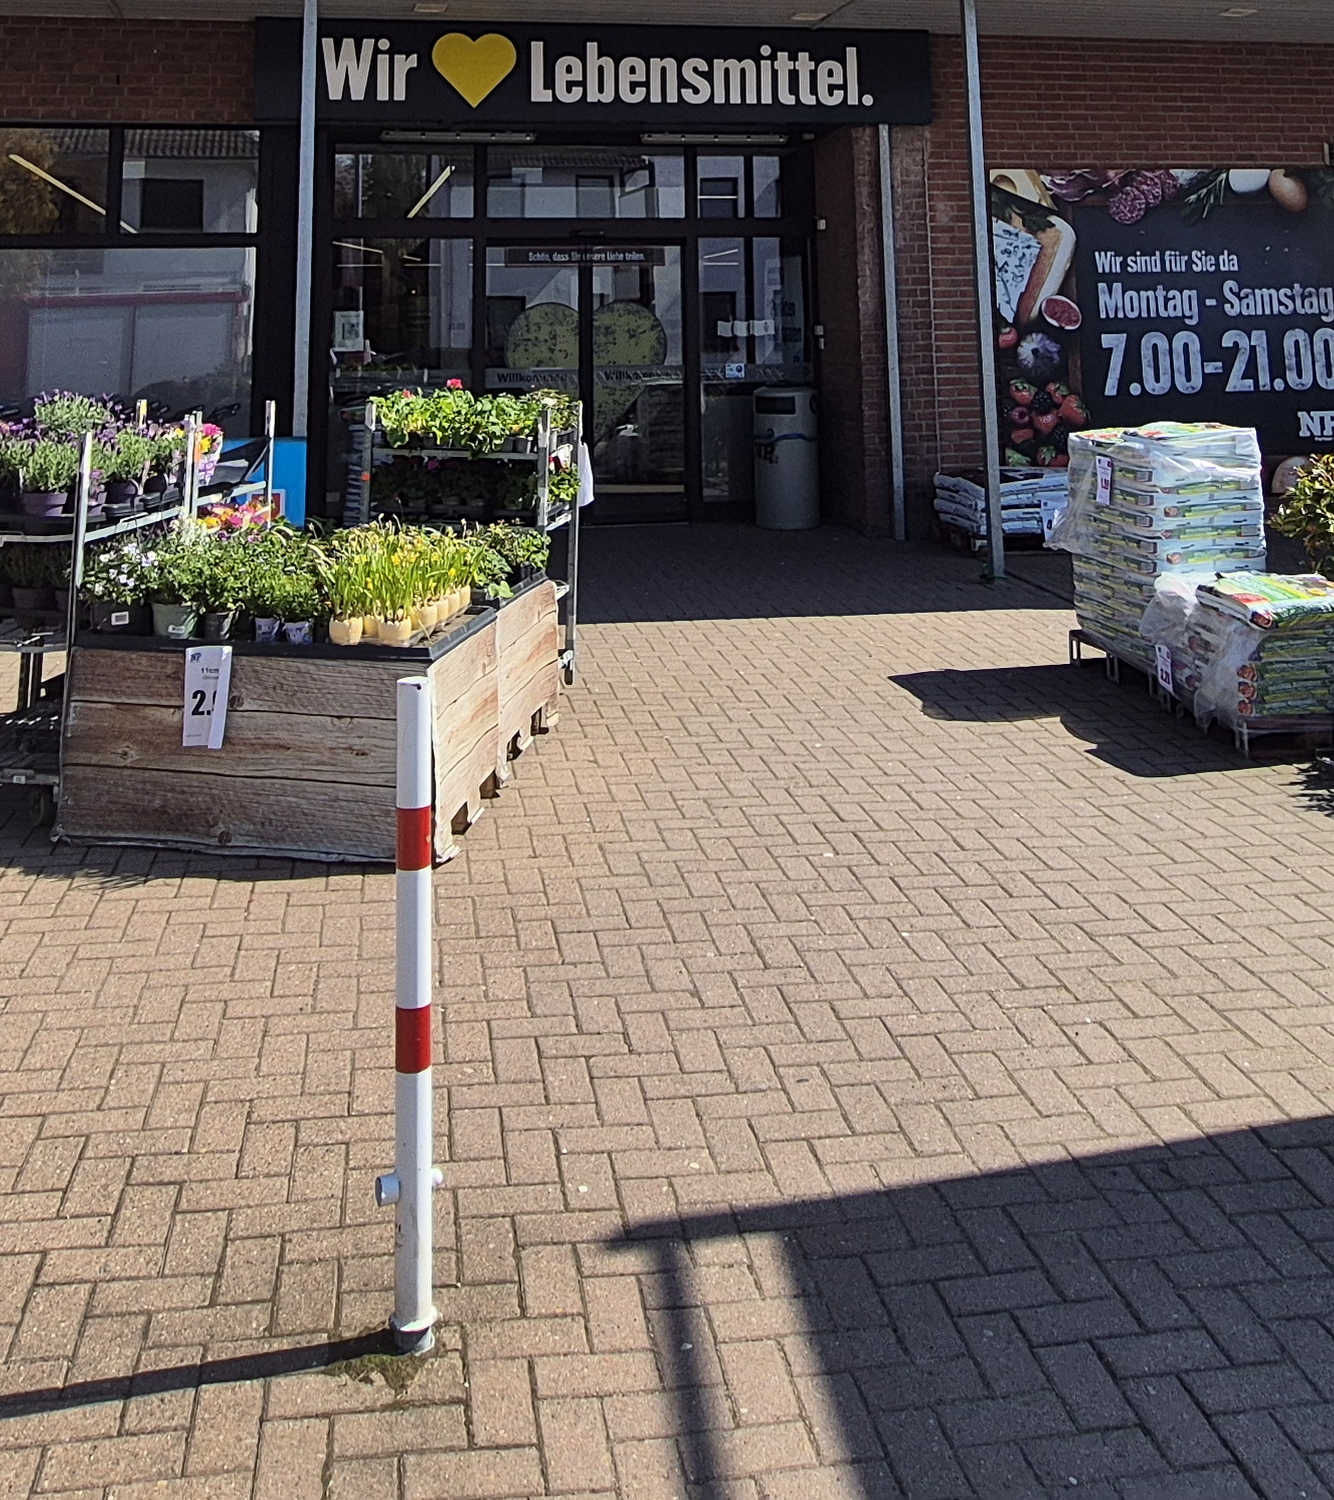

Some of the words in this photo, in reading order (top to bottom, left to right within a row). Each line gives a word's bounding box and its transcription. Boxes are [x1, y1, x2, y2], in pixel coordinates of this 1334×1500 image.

[322, 37, 418, 102] Wir
[530, 40, 874, 107] Lebensmittel.
[553, 252, 569, 262] dass
[1094, 251, 1123, 274] Wir
[1127, 251, 1161, 273] sind
[1165, 251, 1188, 272] für
[1191, 250, 1217, 273] Sie
[1219, 249, 1238, 272] da
[1097, 282, 1199, 326] Montag
